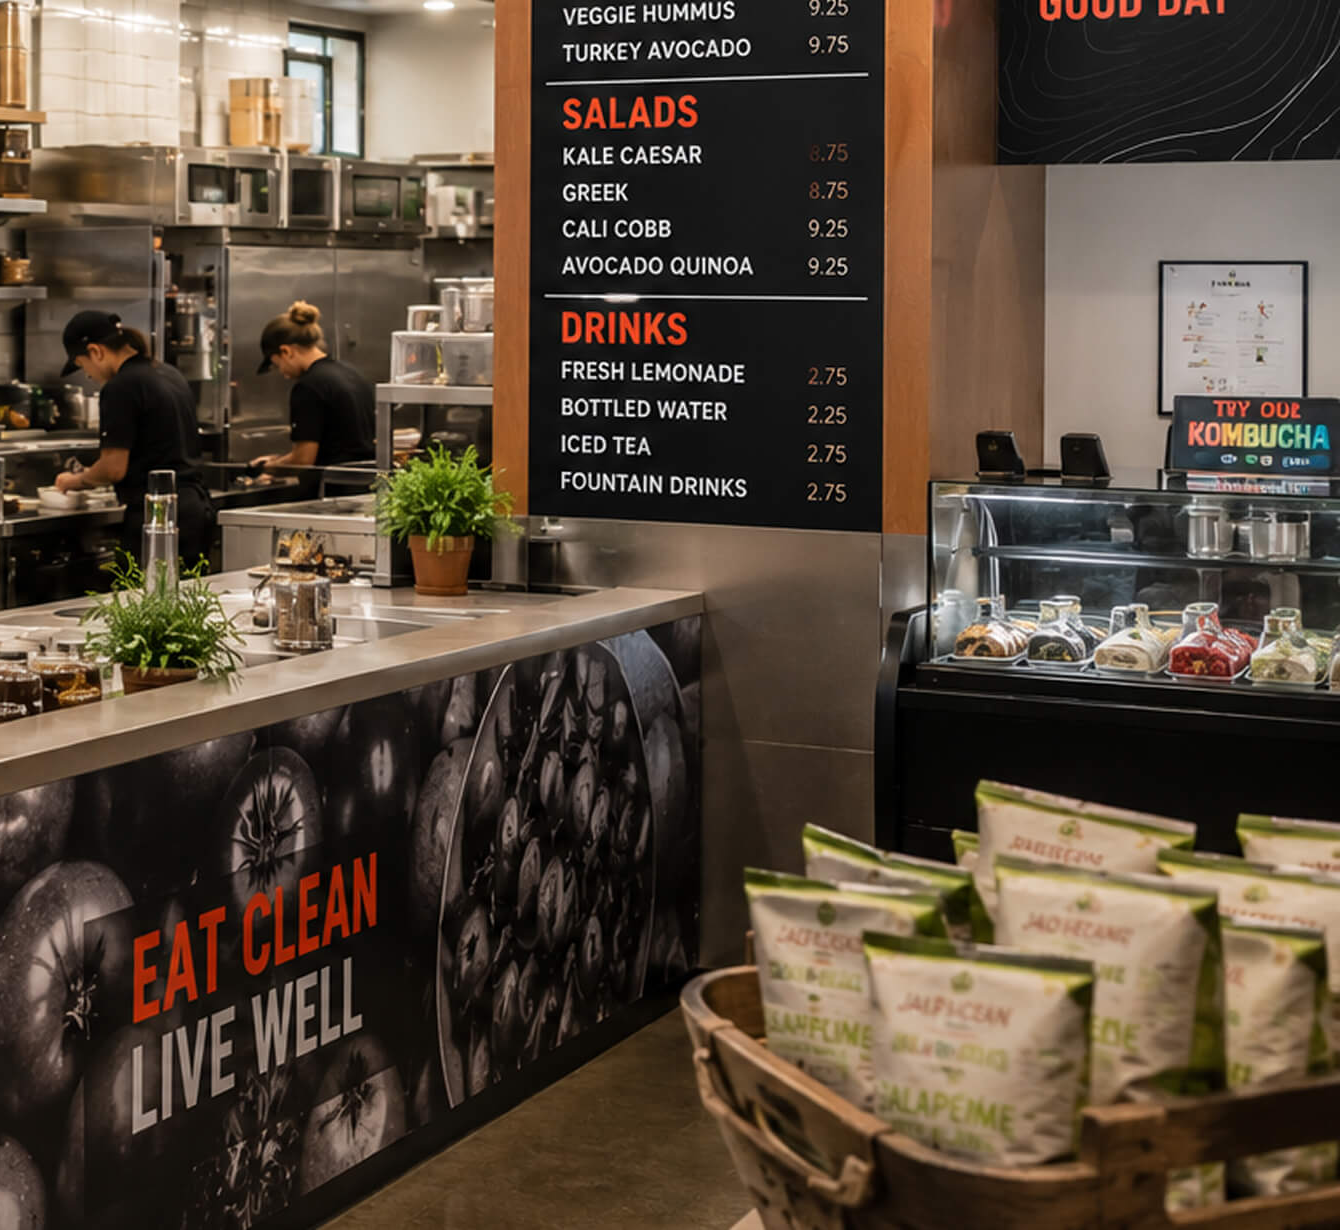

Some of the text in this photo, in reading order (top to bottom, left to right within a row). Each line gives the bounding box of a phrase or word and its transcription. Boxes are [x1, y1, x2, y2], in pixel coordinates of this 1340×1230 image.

[562, 0, 849, 25] VEGGIE HUMMUS 9.25
[562, 35, 849, 62] TURKEY AVOCADO 9.75
[562, 95, 698, 129] SALADS
[563, 143, 849, 166] KALE CAESAR 8.75
[562, 181, 849, 202] GREEK 8.75
[562, 219, 849, 239] CALI COBB 9.25
[561, 256, 849, 276] AVOCADO QUINOA 9.25
[561, 311, 688, 346] DRINKS
[561, 361, 848, 386] FRESH LEMONADE 2.75
[561, 397, 848, 424] BOTTLED WATER 2.25
[1187, 420, 1331, 449] KOMBUCHA
[561, 435, 847, 464] ICED TEA 2.75
[560, 471, 847, 502] FOUNTAIN DRINKS 2.75
[132, 852, 378, 1024] EAT CLEAN
[132, 956, 363, 1135] LIVE WELL
